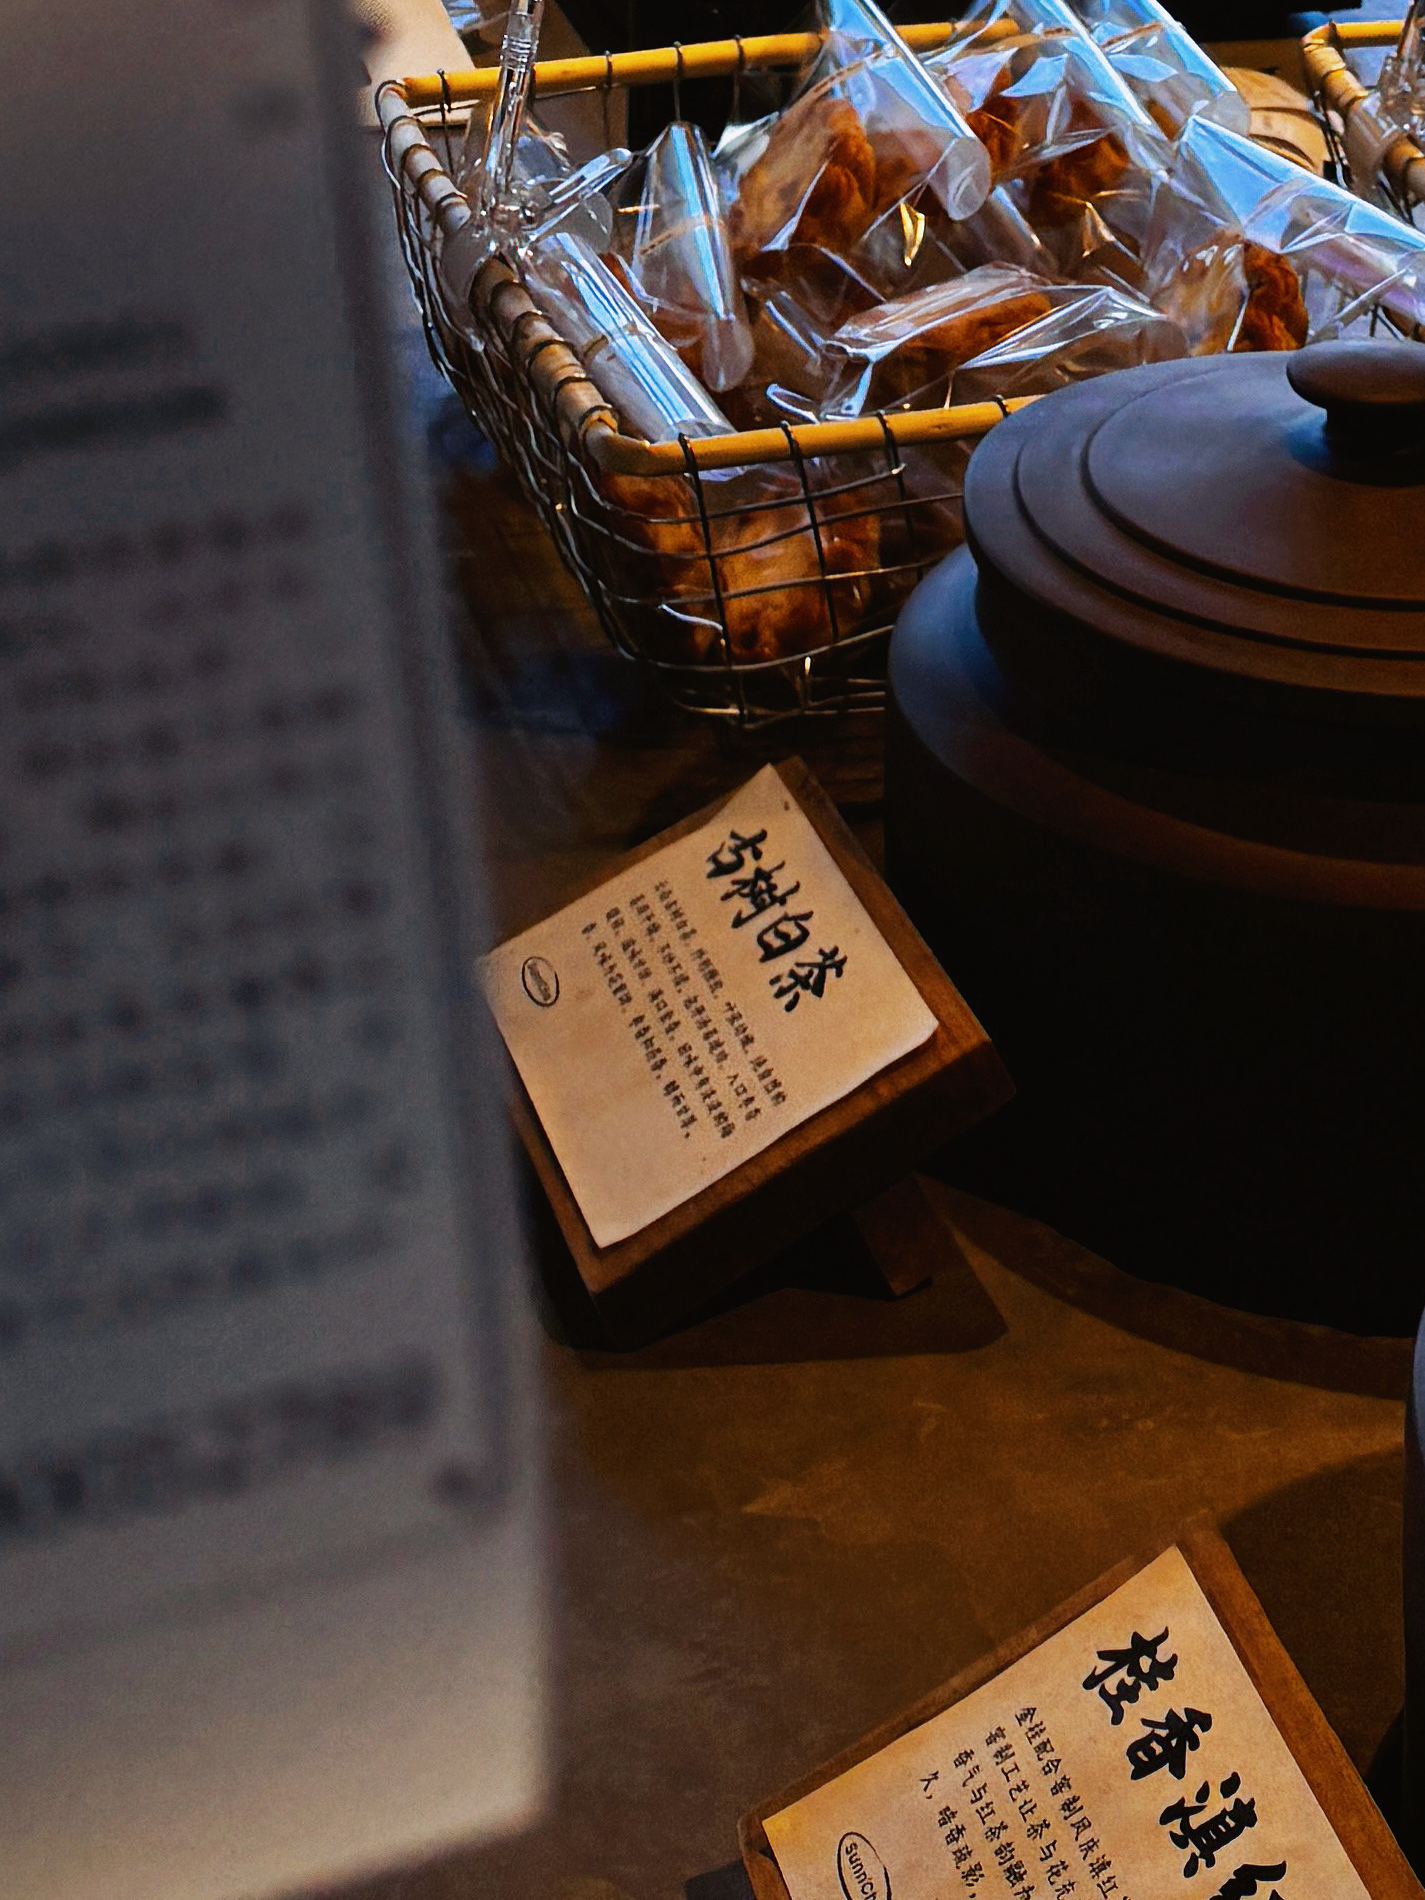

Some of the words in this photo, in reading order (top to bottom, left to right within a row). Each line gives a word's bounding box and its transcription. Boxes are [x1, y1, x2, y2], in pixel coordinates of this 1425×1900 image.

[706, 827, 847, 1012] 古树白茶
[1015, 1706, 1132, 1900] 金桂配合窨制凤庆滇红
